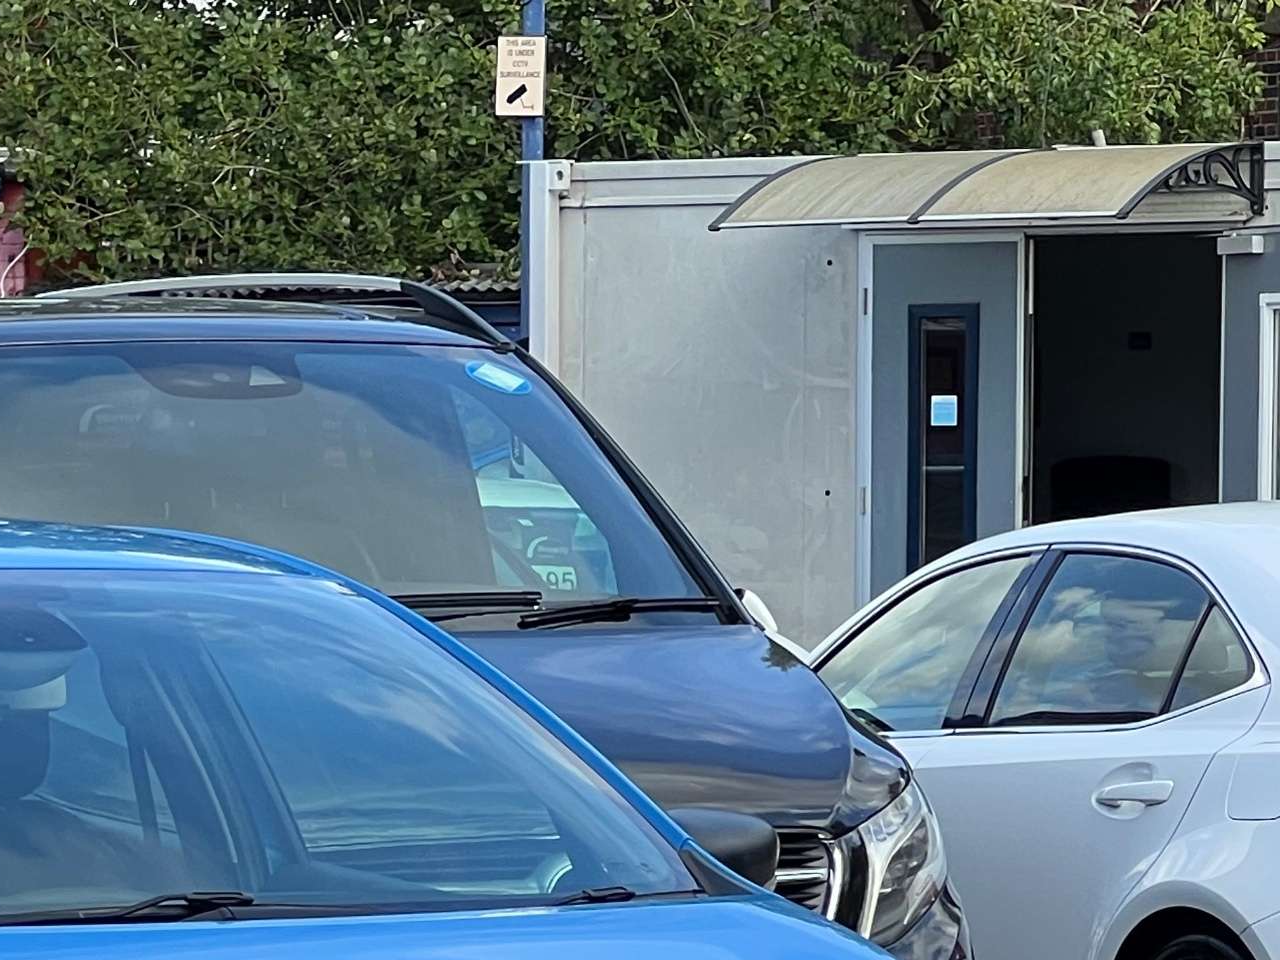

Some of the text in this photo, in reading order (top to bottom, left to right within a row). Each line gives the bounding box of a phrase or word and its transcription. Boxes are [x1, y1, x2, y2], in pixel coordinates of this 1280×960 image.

[521, 39, 536, 47] AREA
[515, 49, 535, 57] UNDER
[512, 60, 528, 68] CCTV
